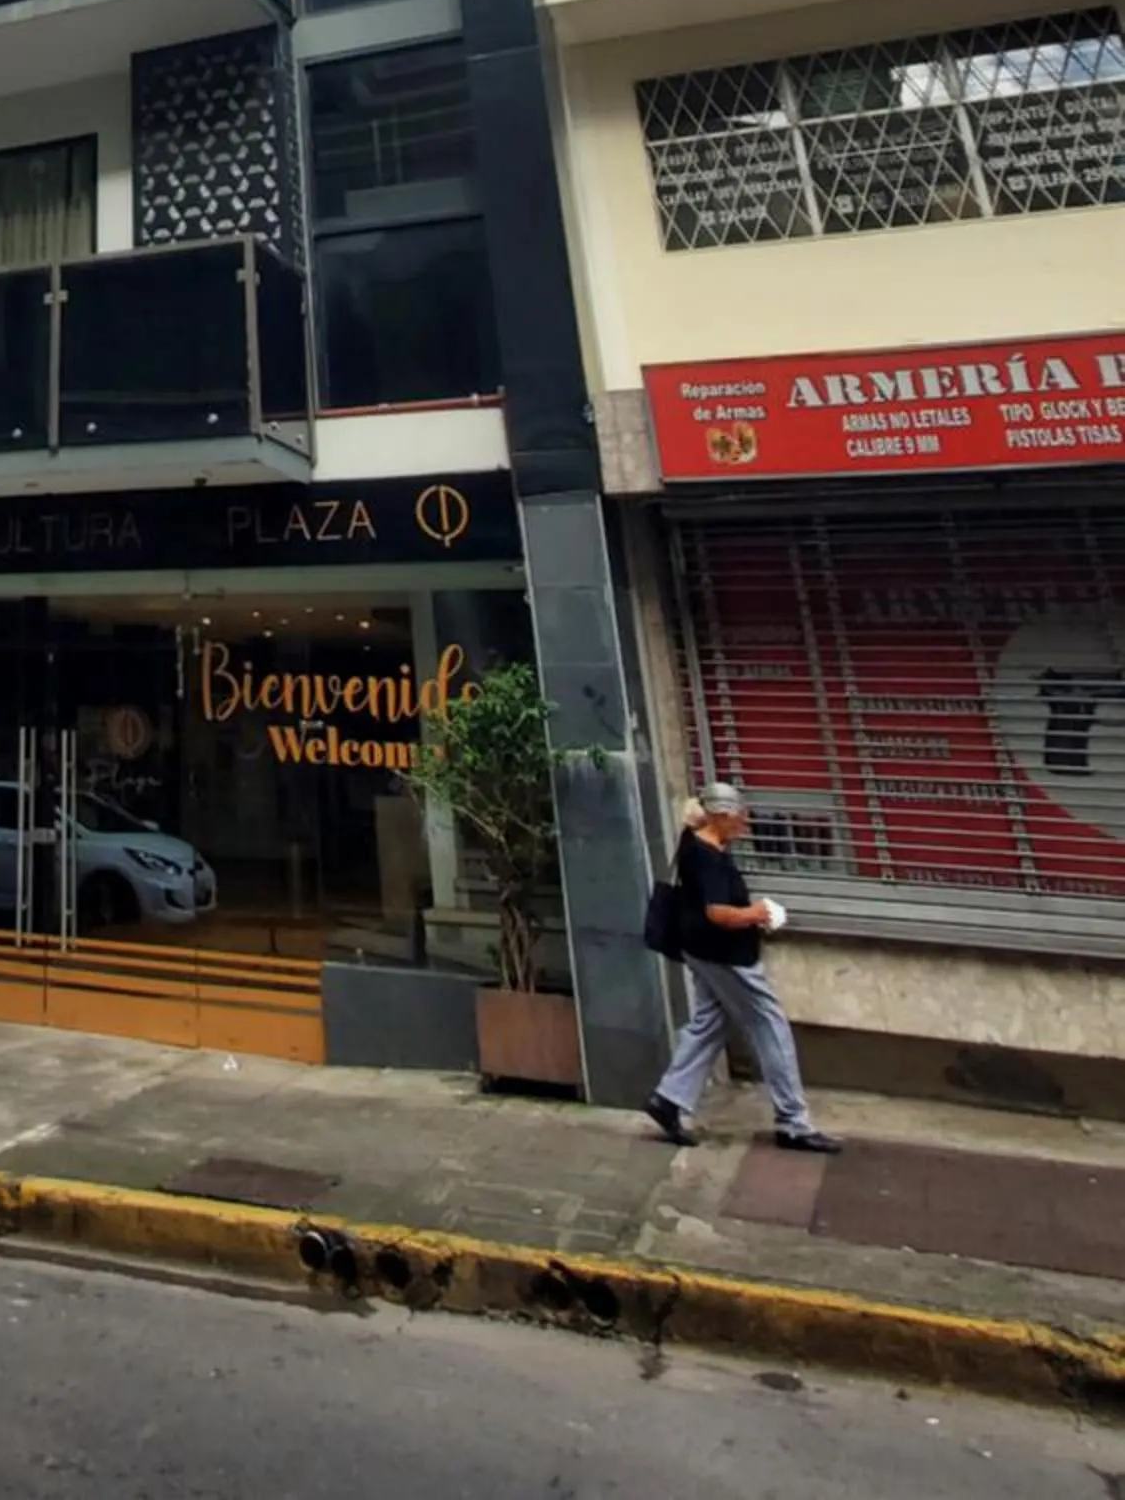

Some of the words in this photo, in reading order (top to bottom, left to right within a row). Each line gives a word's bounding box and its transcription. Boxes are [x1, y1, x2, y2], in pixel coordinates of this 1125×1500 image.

[681, 379, 767, 401] Reparación
[786, 352, 1081, 408] ARMERÍA
[693, 405, 712, 420] de
[715, 402, 766, 420] Armas
[842, 412, 887, 432] ARMAS
[889, 411, 911, 429] NO
[913, 407, 972, 428] LETALES
[998, 402, 1034, 422] TIPO
[1040, 399, 1091, 420] GLOCK
[1090, 397, 1103, 417] Y
[846, 435, 903, 458] CALIBRE
[905, 437, 915, 455] 9
[1005, 427, 1076, 449] PISTOLAS
[227, 500, 376, 546] PLAZA
[268, 725, 446, 769] Welcom
